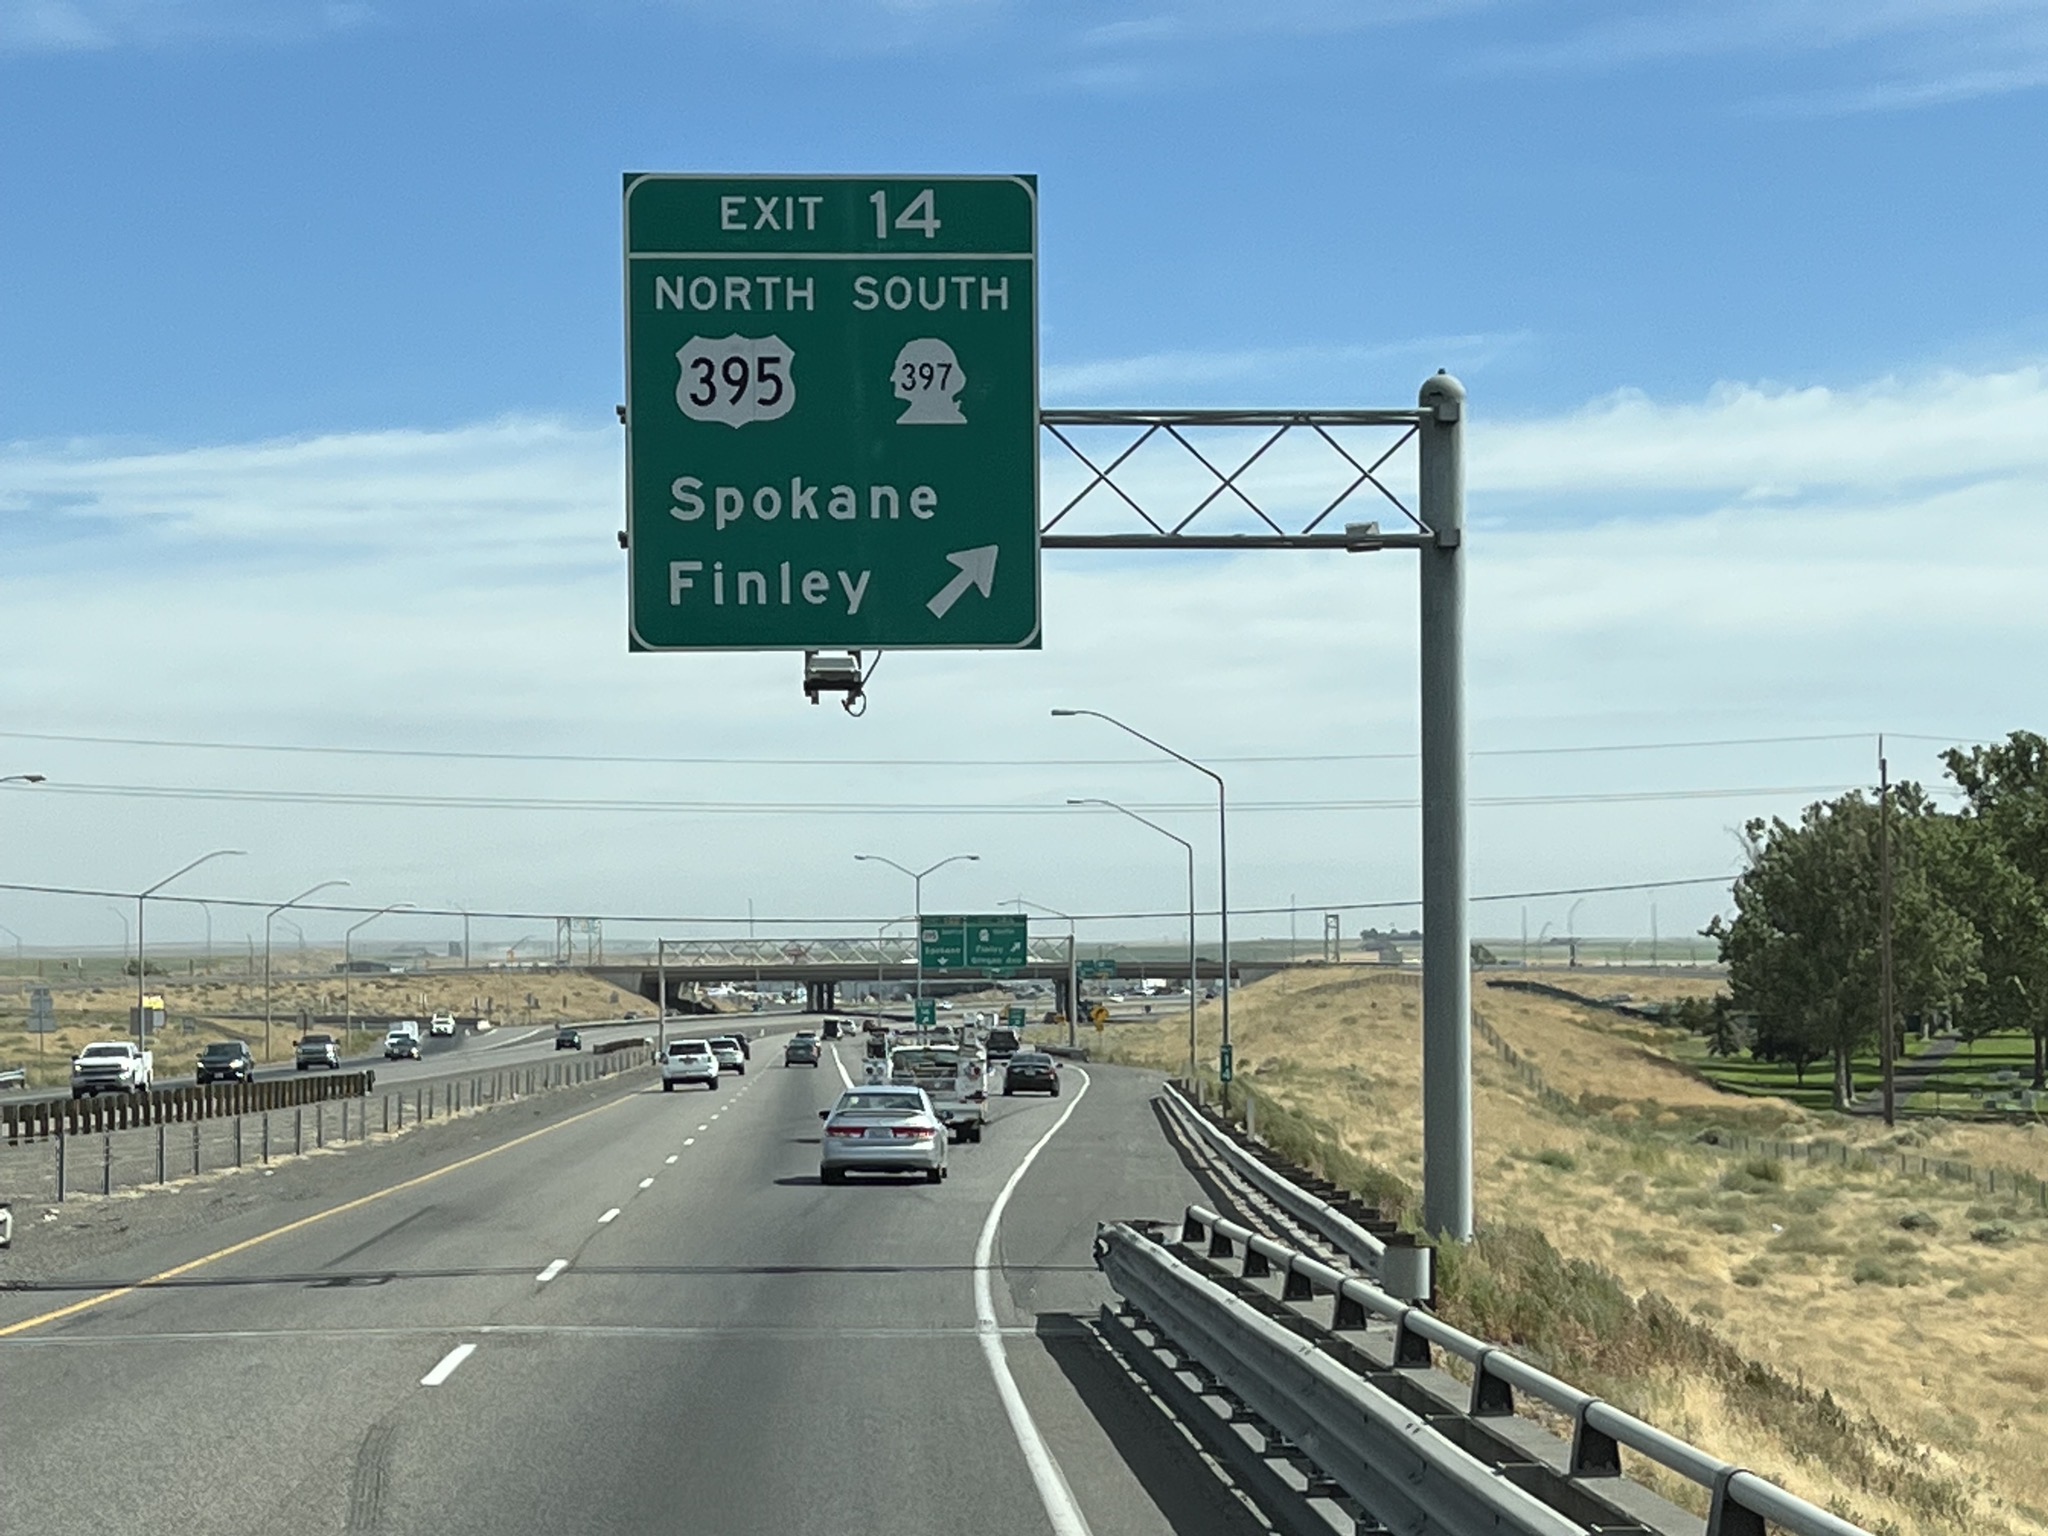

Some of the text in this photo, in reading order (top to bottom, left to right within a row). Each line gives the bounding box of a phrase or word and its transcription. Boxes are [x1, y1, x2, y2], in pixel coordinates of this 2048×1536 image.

[721, 189, 941, 239] EXIT 14
[655, 276, 1009, 311] NORTH SOUTH
[689, 356, 784, 407] 395
[901, 362, 953, 392] 397
[670, 476, 937, 530] Spokane
[669, 561, 871, 615] Finley
